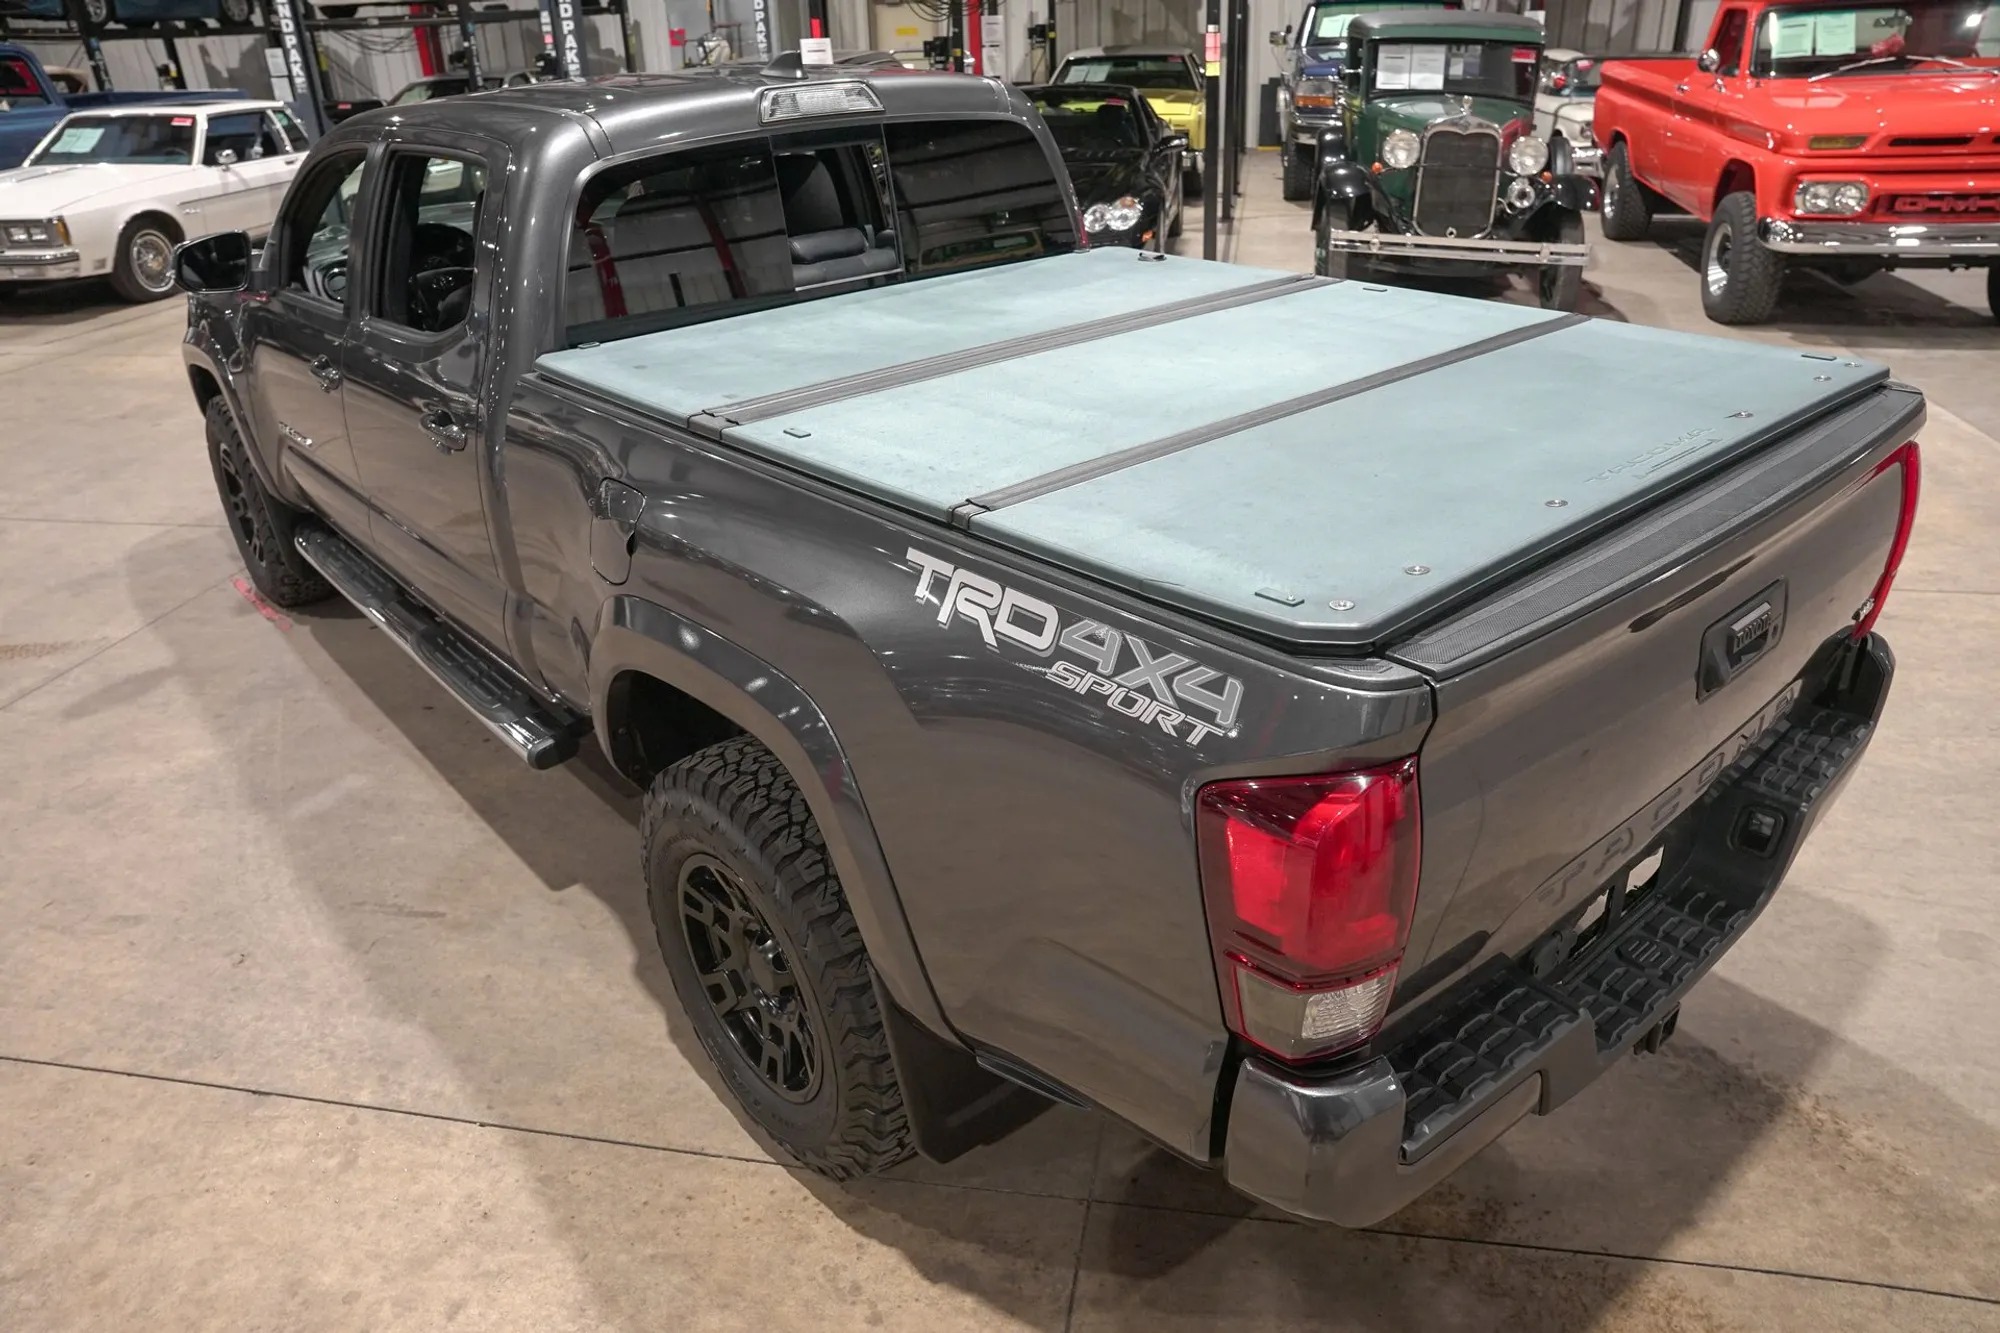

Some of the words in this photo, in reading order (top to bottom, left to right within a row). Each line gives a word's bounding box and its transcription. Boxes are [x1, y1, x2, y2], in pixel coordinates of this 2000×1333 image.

[275, 0, 305, 77] NDPAK
[558, 0, 580, 63] DPAK
[1894, 195, 2000, 212] GM
[906, 546, 1060, 657] TRD
[1059, 618, 1244, 728] 4X4
[1045, 660, 1224, 746] SPORT
